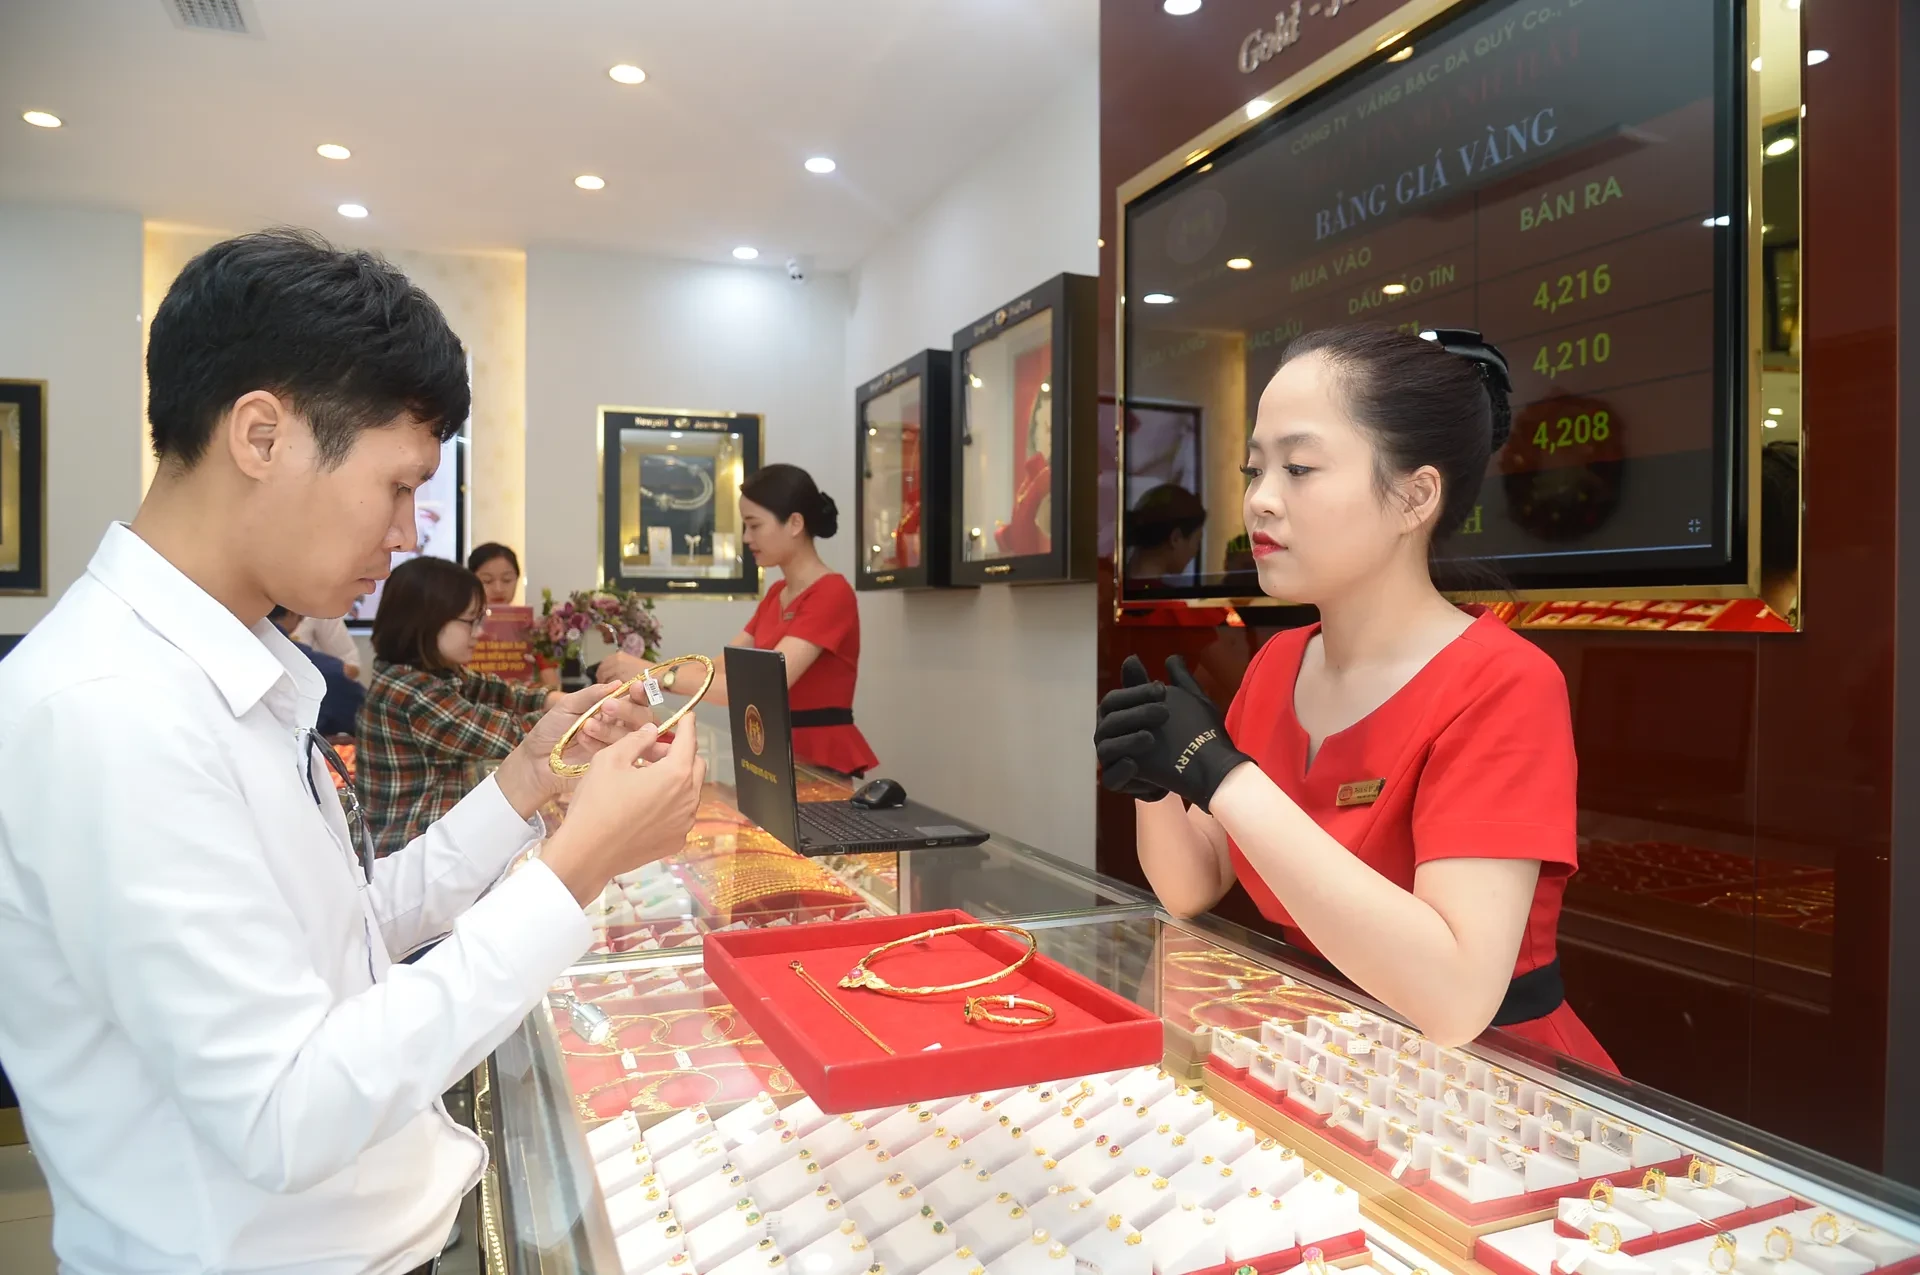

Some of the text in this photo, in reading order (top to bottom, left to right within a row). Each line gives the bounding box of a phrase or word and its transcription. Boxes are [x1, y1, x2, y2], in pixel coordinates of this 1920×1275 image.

[1238, 0, 1302, 73] Gold
[1316, 182, 1388, 241] BẢNG
[1395, 147, 1449, 206] GIÁ
[1456, 107, 1558, 178] VÀNG
[1519, 175, 1624, 232] BÁN RA
[1290, 263, 1329, 294] MUA
[1533, 263, 1611, 314] 4,216
[1532, 332, 1611, 380] 4,210
[1533, 410, 1610, 455] 4,208
[1174, 728, 1217, 775] JEWELRY
